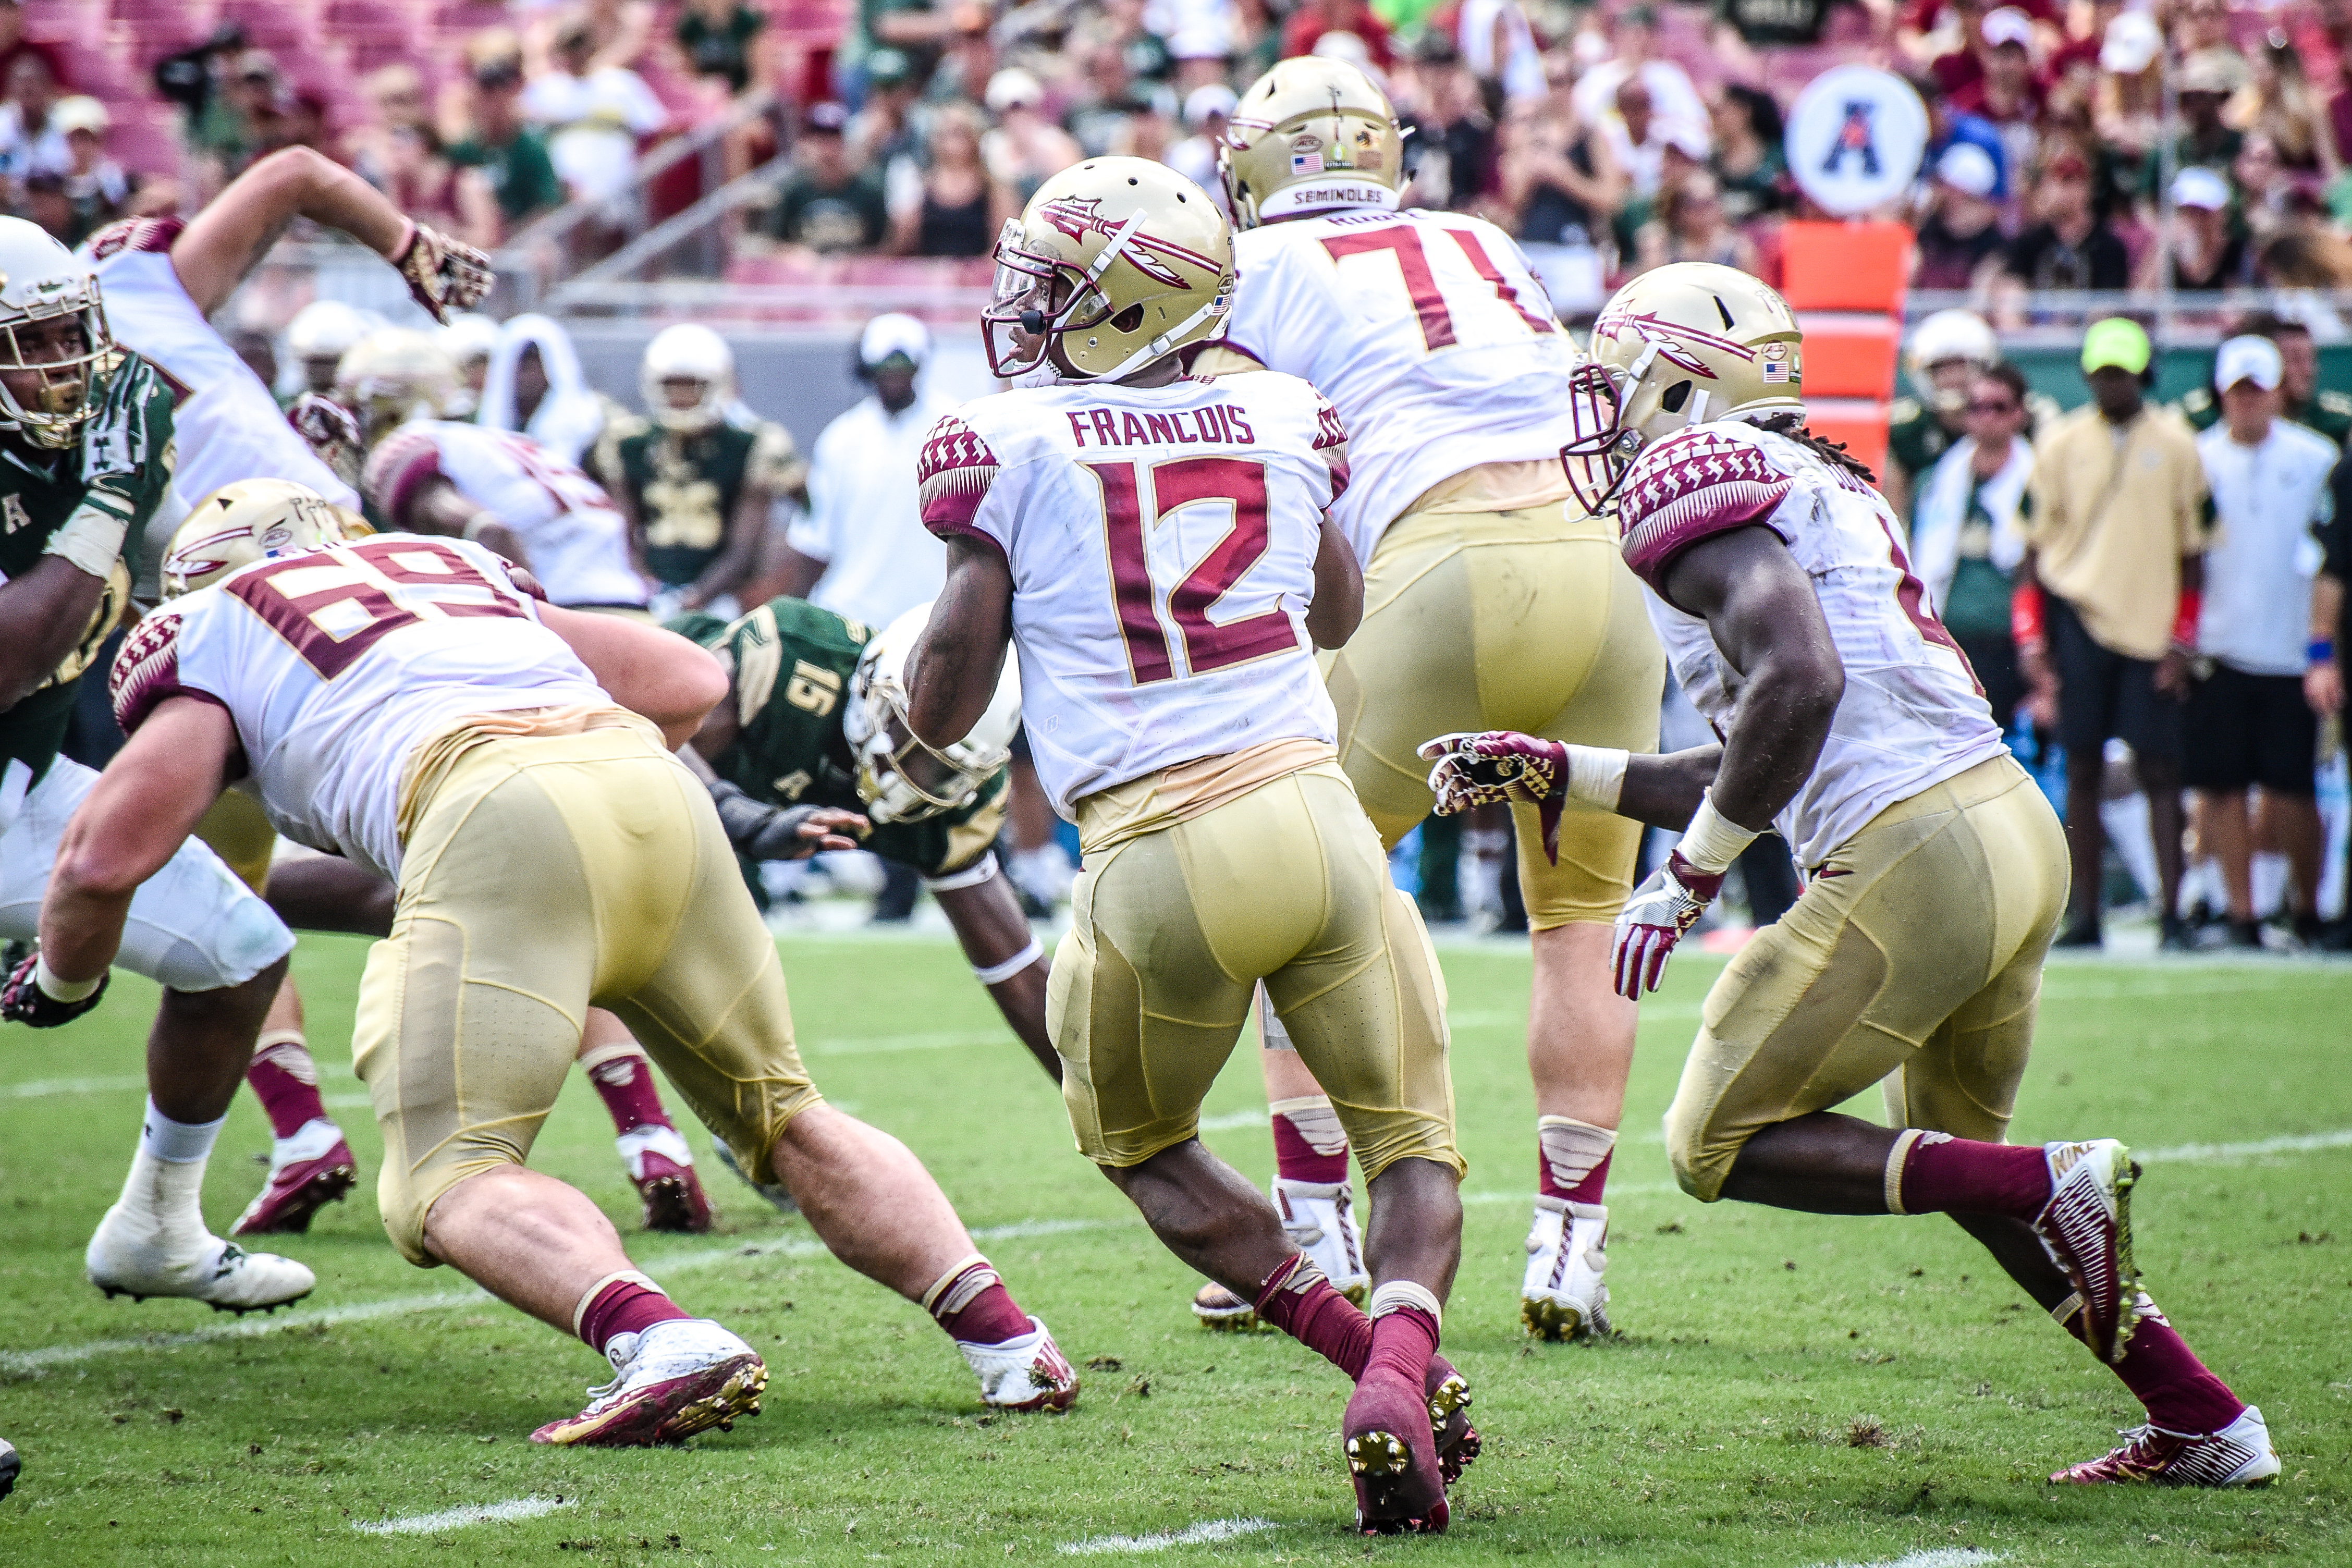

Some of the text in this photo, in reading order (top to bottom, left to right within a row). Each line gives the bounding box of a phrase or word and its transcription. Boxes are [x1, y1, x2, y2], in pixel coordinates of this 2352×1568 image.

[1294, 189, 1383, 205] SEMINOLES
[1315, 225, 1556, 356] 71
[1065, 405, 1255, 447] FRANCOIS
[2, 493, 31, 534] A
[1074, 454, 1302, 687] 12
[221, 542, 531, 685] 69
[785, 658, 841, 718] 15
[2052, 1142, 2097, 1180] NIKE
